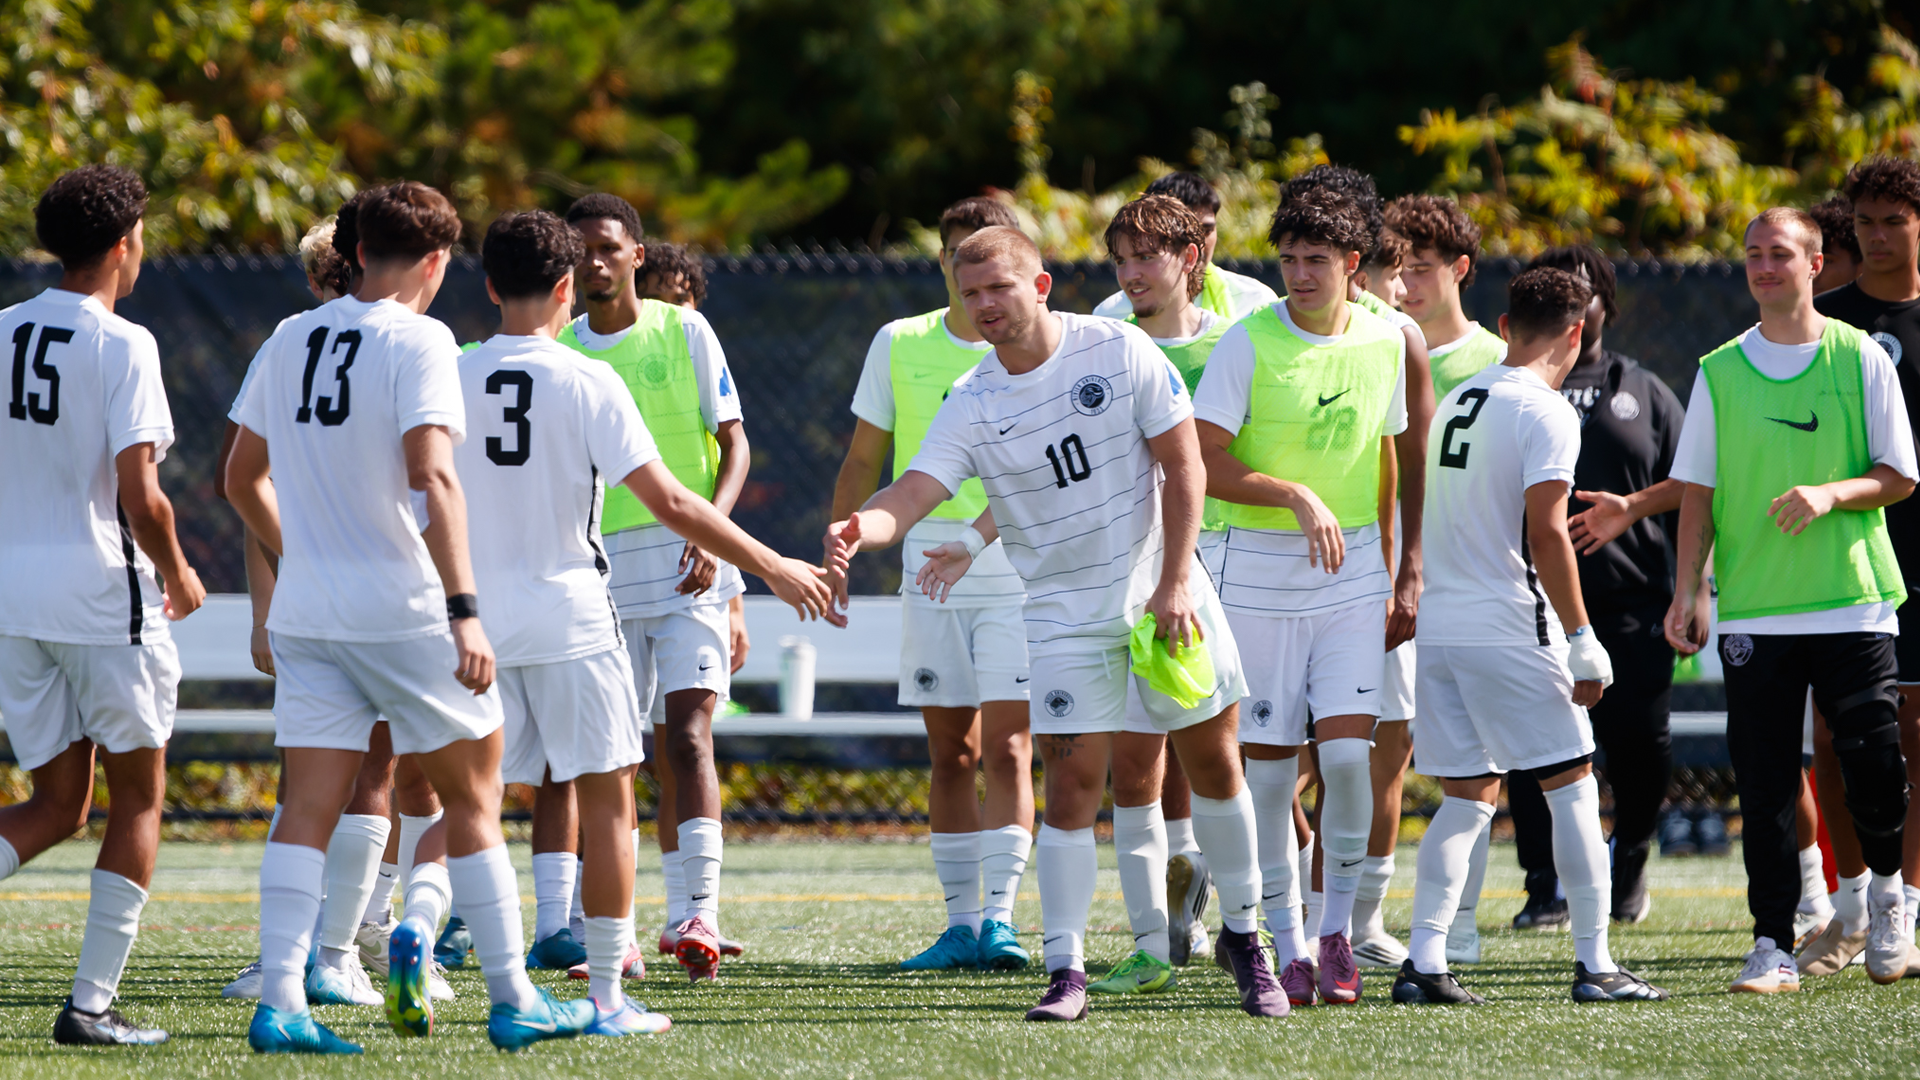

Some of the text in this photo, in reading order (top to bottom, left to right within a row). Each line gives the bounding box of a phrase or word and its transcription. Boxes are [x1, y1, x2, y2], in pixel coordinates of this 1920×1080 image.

[9, 322, 75, 426] 15
[296, 325, 362, 427] 13
[485, 370, 534, 467] 3
[1082, 377, 1111, 391] UNIVERSITY
[1045, 433, 1092, 489] 10
[1439, 387, 1489, 470] 2
